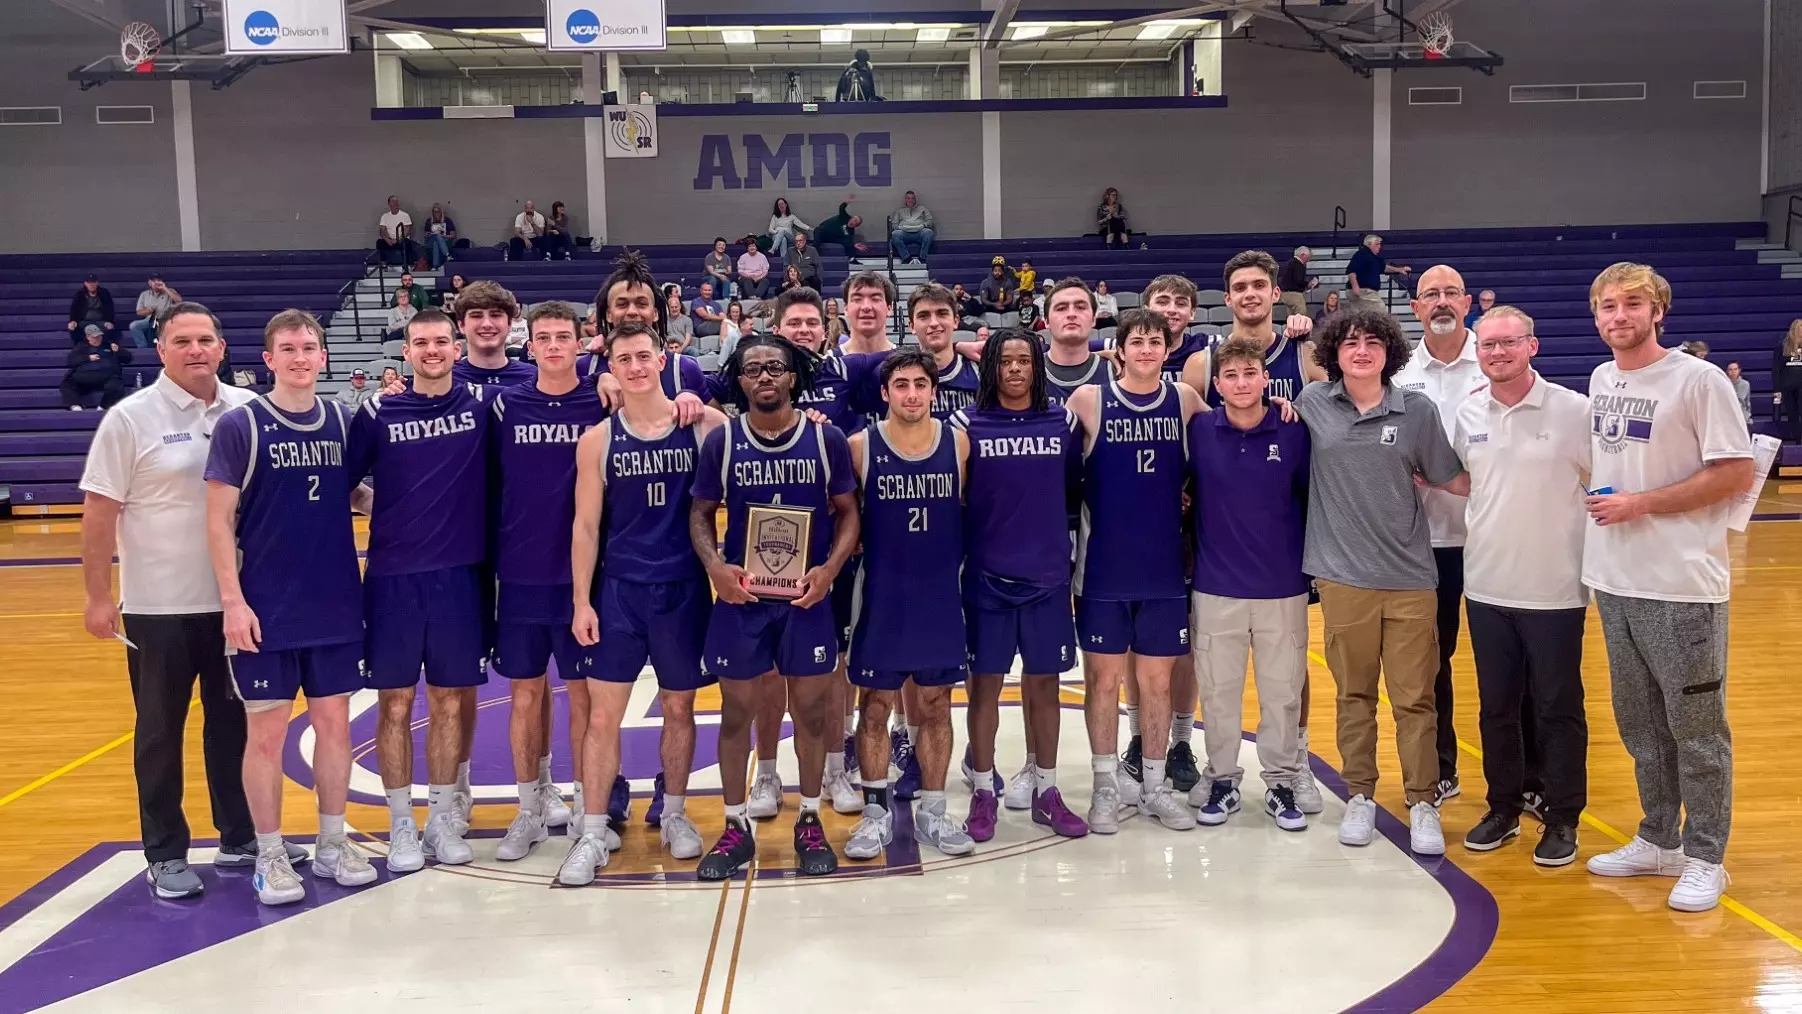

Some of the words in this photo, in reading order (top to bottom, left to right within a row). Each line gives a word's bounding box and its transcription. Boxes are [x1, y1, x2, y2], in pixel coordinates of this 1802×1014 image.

[248, 27, 278, 37] NCAA
[282, 27, 319, 37] Division
[569, 25, 599, 36] NCAA
[602, 25, 639, 35] Division
[609, 111, 626, 122] WU
[637, 136, 652, 148] SR
[693, 131, 892, 190] AMDG
[1592, 394, 1659, 418] SCRANTON
[388, 411, 476, 443] ROYALS
[514, 423, 593, 444] ROYAL
[1106, 417, 1179, 443] SCRANTON
[268, 440, 343, 469] SCRANTON
[978, 436, 1062, 458] ROYALS
[613, 447, 693, 477] SCRANTON
[734, 458, 816, 487] SCRANTON
[1136, 448, 1155, 473] 12
[307, 475, 320, 501] 2
[646, 481, 666, 507] 10
[877, 473, 953, 500] SCRANTON
[908, 506, 928, 532] 21
